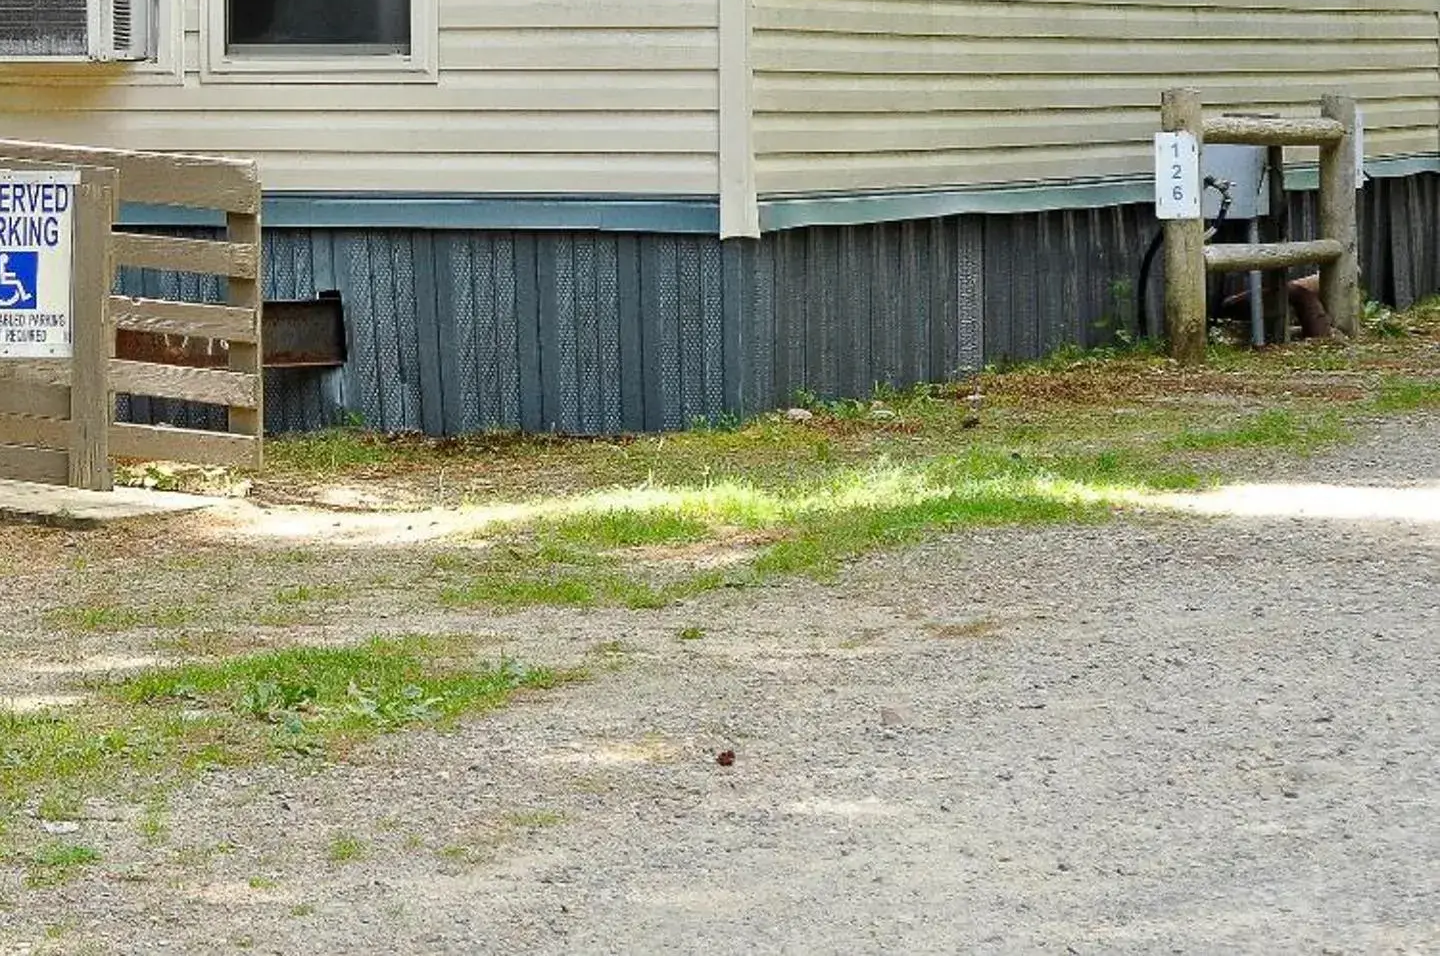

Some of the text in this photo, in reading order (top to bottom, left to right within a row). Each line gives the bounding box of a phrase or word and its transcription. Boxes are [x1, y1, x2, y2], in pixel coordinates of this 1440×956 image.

[1171, 143, 1184, 201] 126
[28, 313, 66, 327] PARKING
[5, 328, 47, 343] REQUIRED
